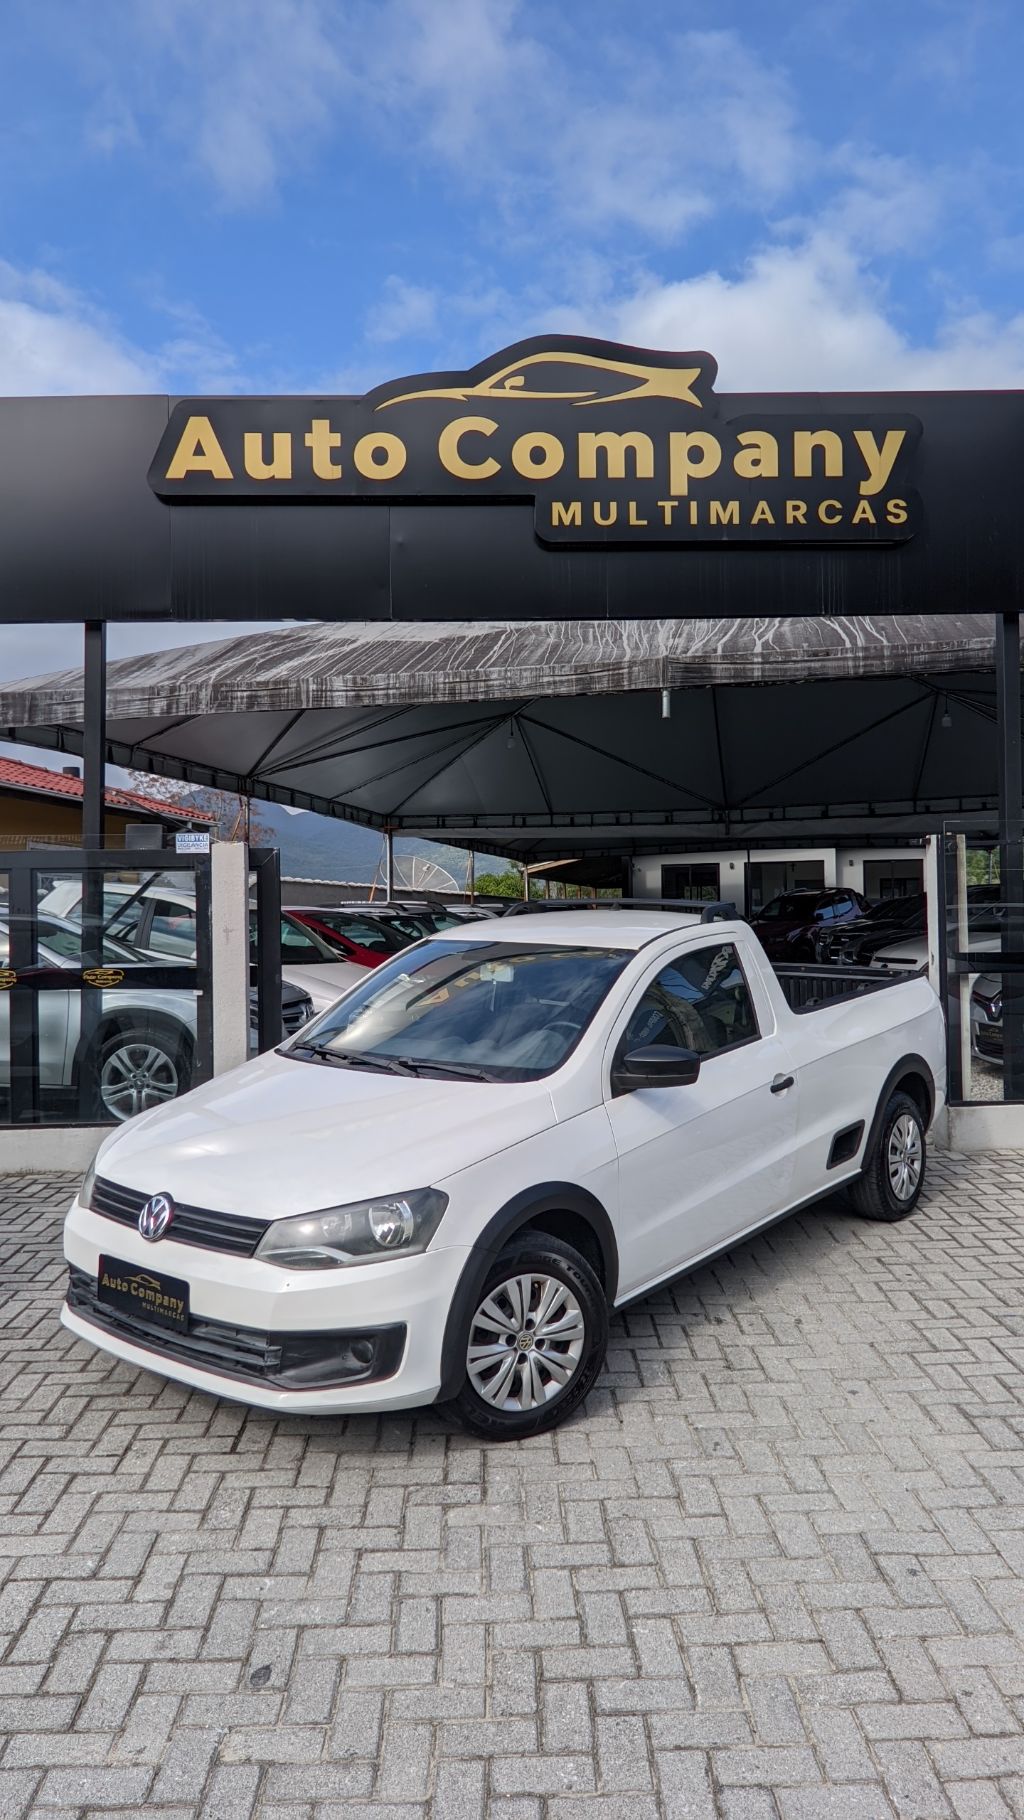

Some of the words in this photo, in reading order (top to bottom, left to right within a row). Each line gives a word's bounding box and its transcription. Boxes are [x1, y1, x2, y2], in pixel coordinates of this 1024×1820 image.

[165, 415, 407, 480] Auto
[438, 415, 907, 497] Company
[551, 499, 909, 526] MULTIMARCAS
[102, 1273, 129, 1292] Auto
[130, 1282, 185, 1314] Company
